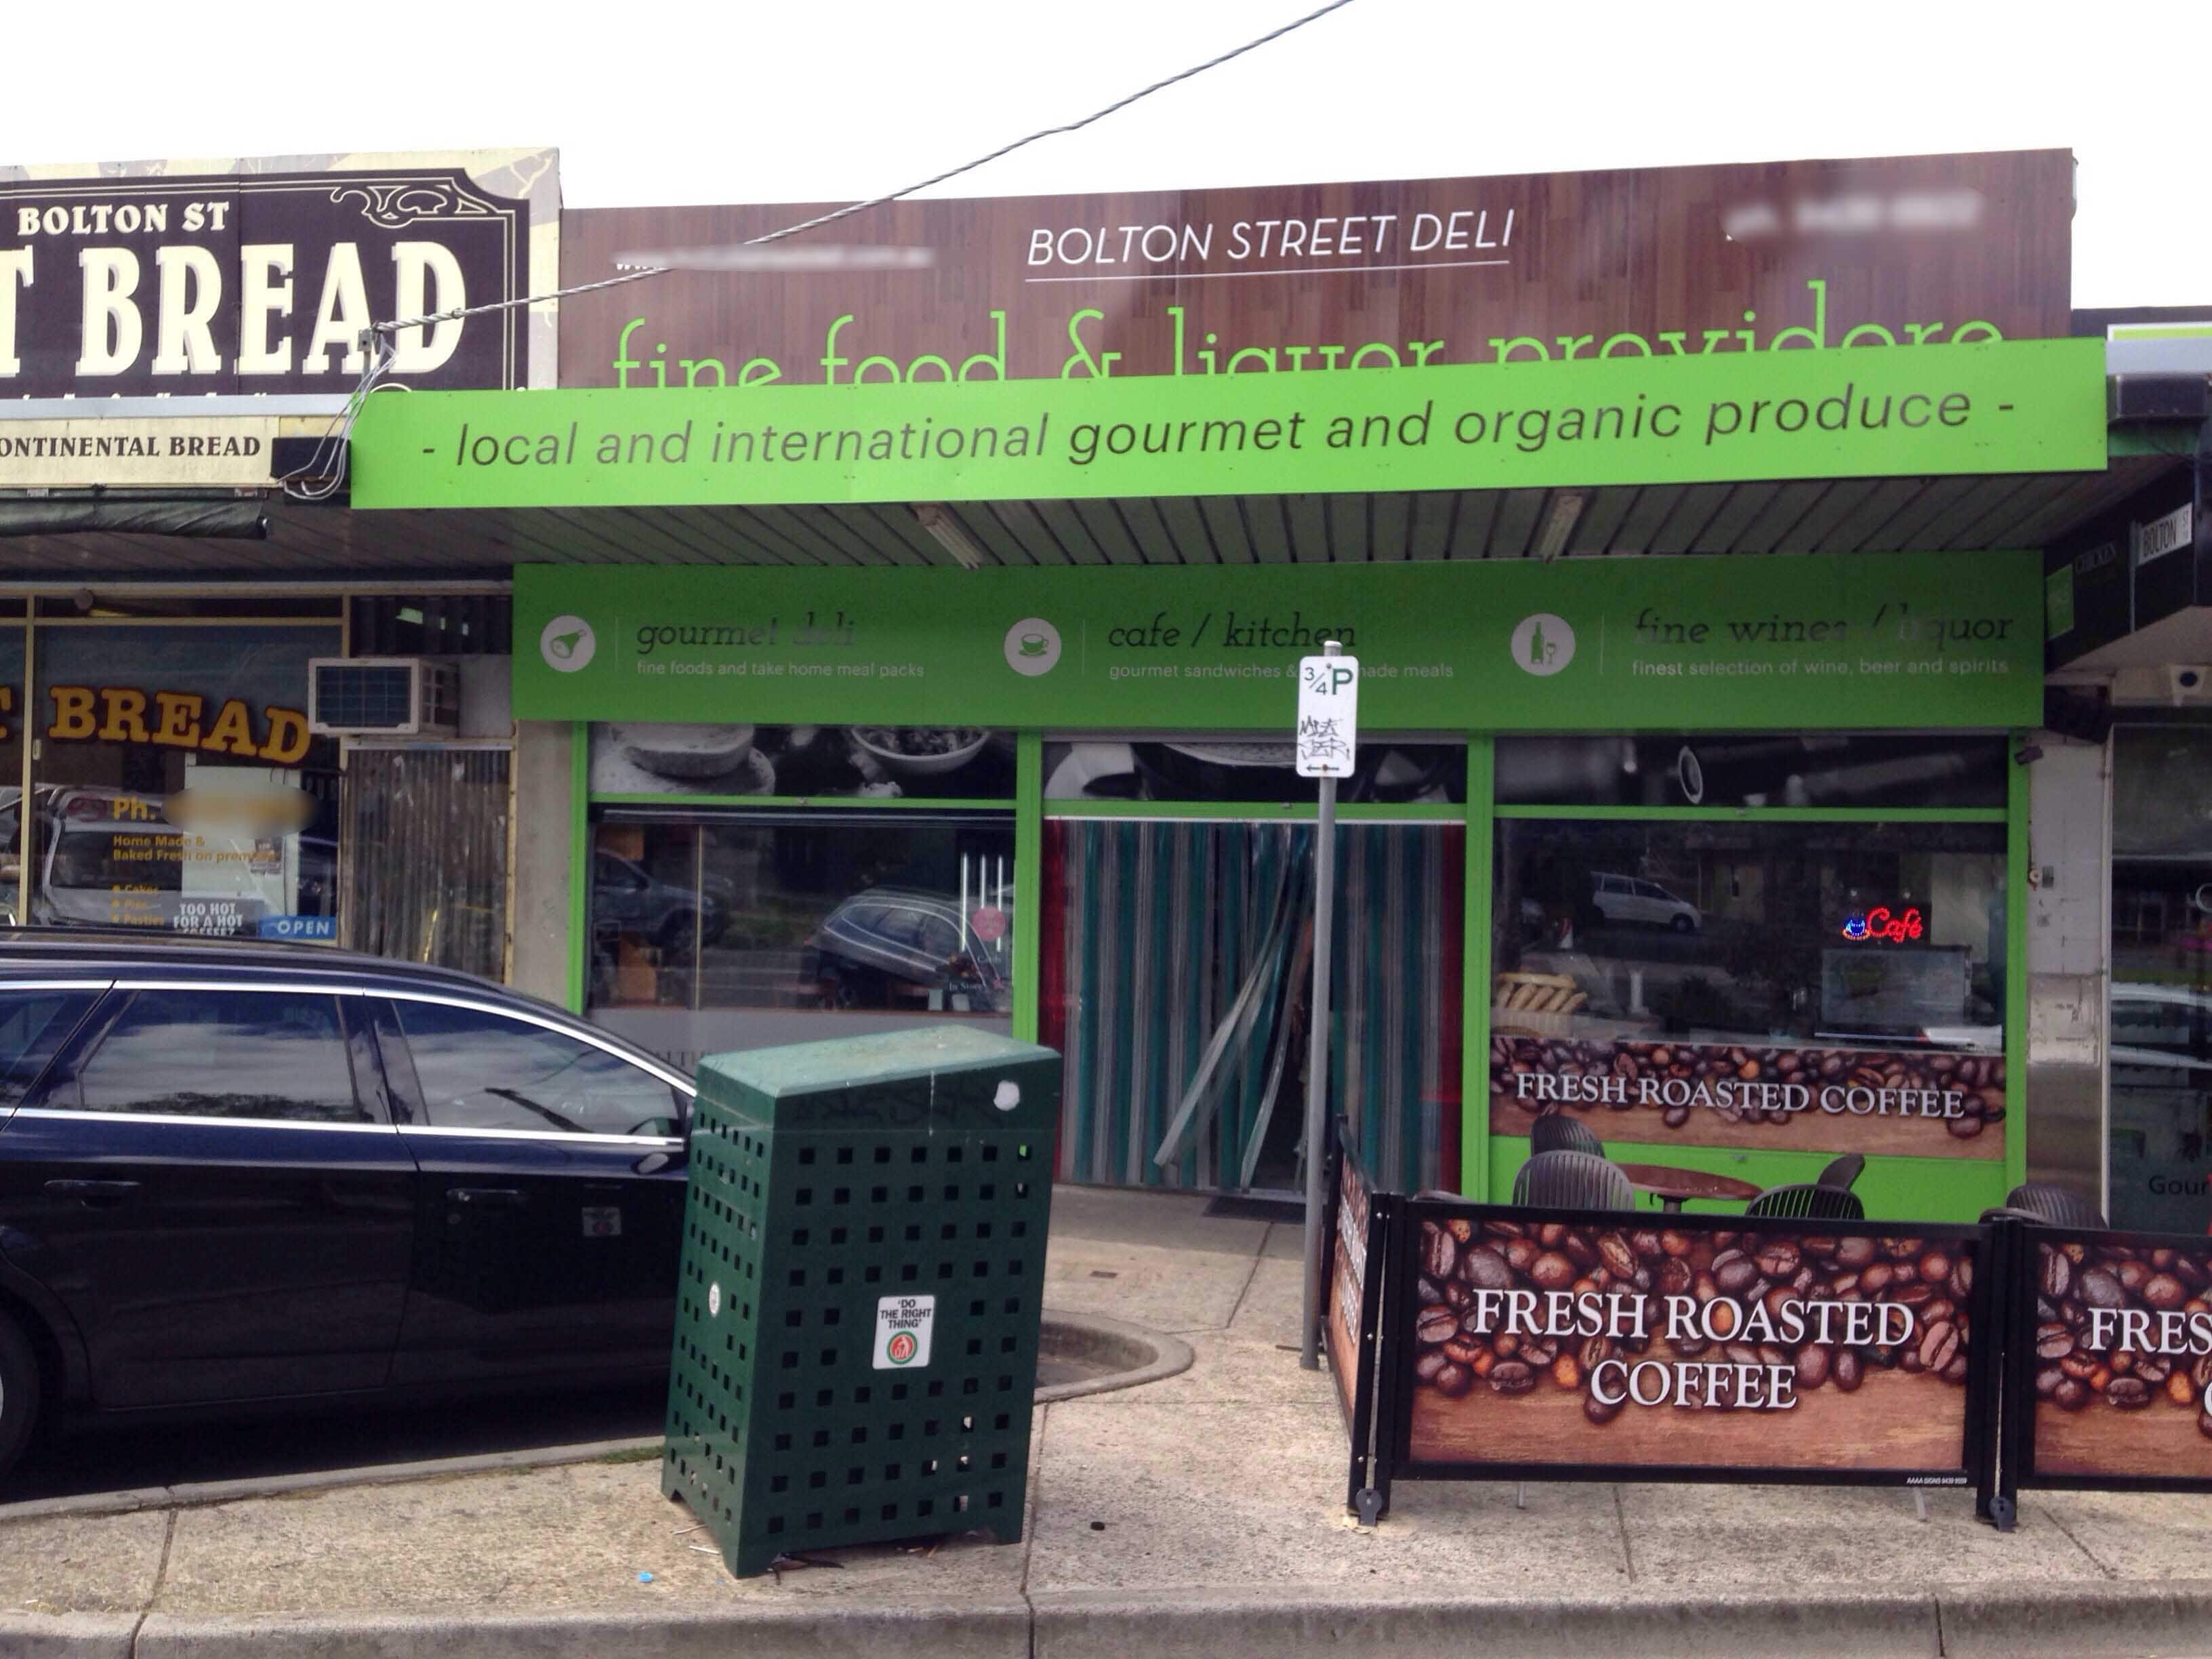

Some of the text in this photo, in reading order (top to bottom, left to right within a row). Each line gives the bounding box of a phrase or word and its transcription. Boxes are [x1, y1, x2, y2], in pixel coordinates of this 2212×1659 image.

[18, 201, 229, 235] BOLTON ST
[1027, 208, 1515, 266] BOLTON STREET DELI
[75, 241, 466, 375] BREAD
[455, 421, 577, 466] local
[596, 419, 693, 465] and
[710, 411, 1050, 464] international
[1068, 410, 1305, 466] gourmet
[1326, 400, 1435, 448] and
[1454, 393, 1681, 452] organic
[1704, 382, 1971, 446] produce
[168, 436, 261, 457] BREAD
[2142, 520, 2177, 559] BOLTON
[636, 611, 856, 655] gourmet deli
[1108, 611, 1181, 649] cafe
[1223, 611, 1357, 649] kitchen
[1634, 608, 1711, 647] fine
[1727, 613, 1849, 642] wines
[1896, 602, 2015, 653] liquor
[636, 660, 925, 679] fine foods and take home meal packs
[1109, 665, 1179, 681] gourmet
[1184, 663, 1281, 678] sandwiches
[1404, 663, 1454, 678] meals
[1631, 660, 1683, 676] finest
[1688, 659, 1774, 676] selection
[1778, 659, 1799, 674] of
[1859, 658, 1902, 674] beer
[1906, 657, 1944, 674] and
[1949, 657, 2009, 675] spirits
[48, 686, 311, 764] BREAD
[112, 796, 157, 821] Ph.
[112, 835, 152, 847] Home
[155, 834, 192, 847] Made
[112, 849, 153, 862] Baked
[157, 850, 192, 862] Fresh
[194, 851, 212, 862] on
[173, 915, 243, 928] FOR A HOT
[180, 902, 237, 916] TOO HOT
[276, 920, 330, 935] OPEN
[1517, 1073, 1965, 1119] FRESH ROASTED COFFEE
[880, 1308, 932, 1319] THE RIGHT
[1473, 1288, 1914, 1347] FRESH ROASTED
[1589, 1359, 1798, 1410] COFFEE
